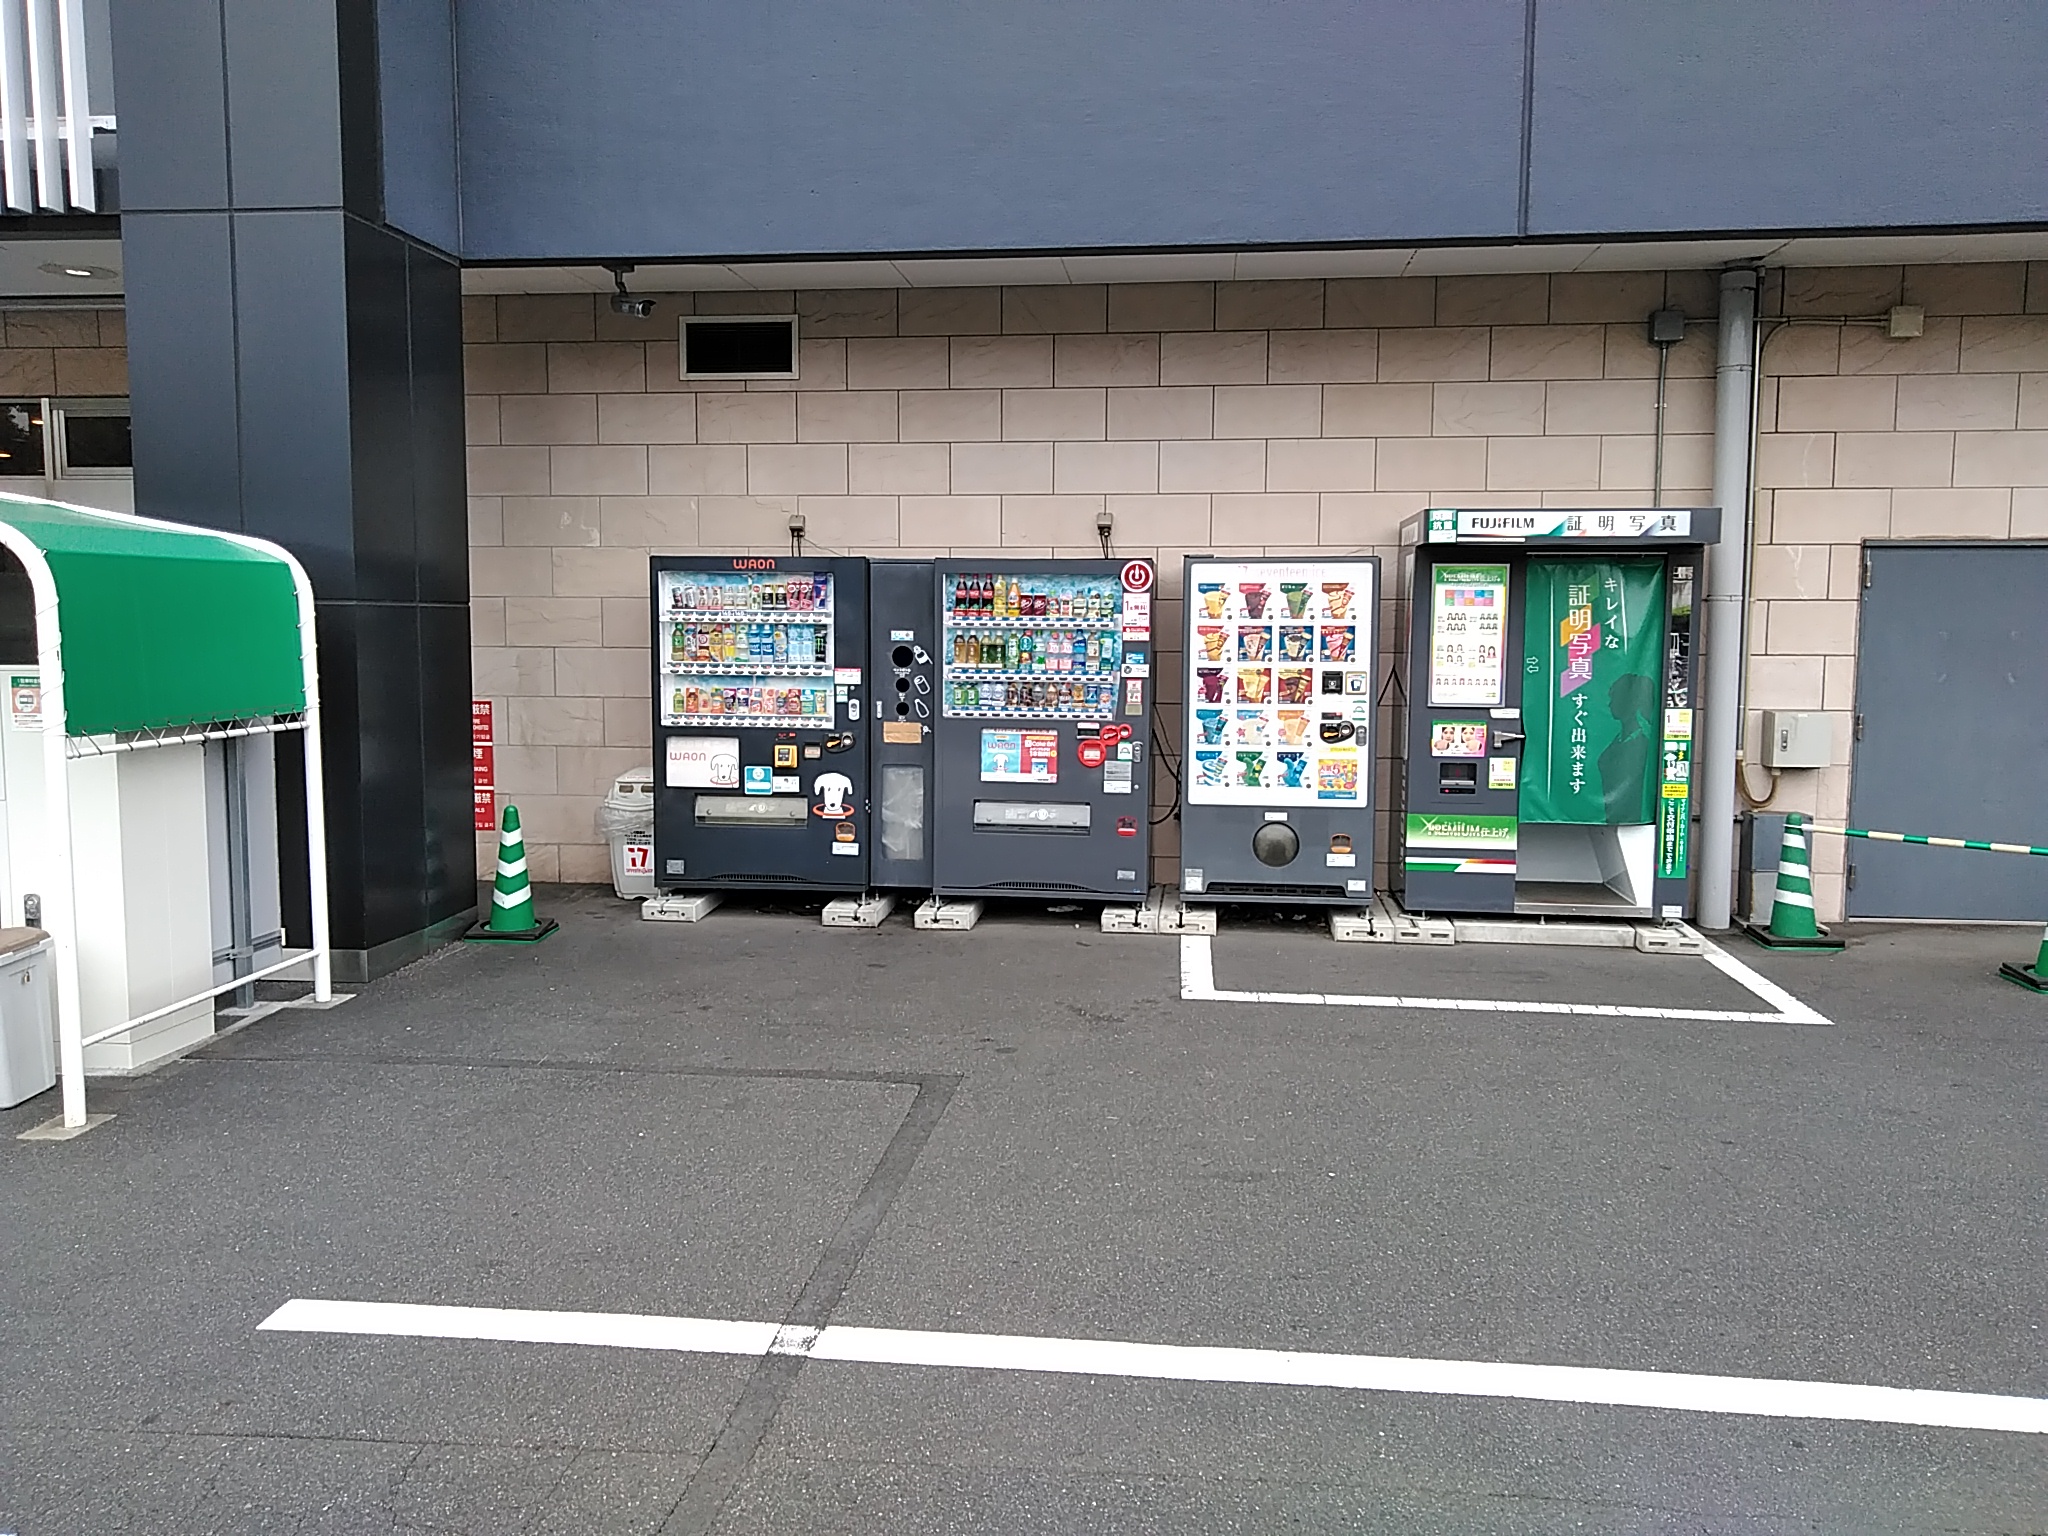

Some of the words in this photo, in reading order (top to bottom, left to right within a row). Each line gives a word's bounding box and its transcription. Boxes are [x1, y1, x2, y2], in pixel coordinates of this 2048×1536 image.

[1472, 517, 1535, 529] FUJIFILM
[1567, 515, 1677, 532] 証明写真
[733, 558, 776, 570] WAON
[1604, 577, 1619, 649] キレイな
[1568, 584, 1592, 680] 証明写真
[987, 741, 1016, 750] WAON
[1569, 692, 1588, 795] すぐ出来ます
[669, 751, 707, 762] WAON
